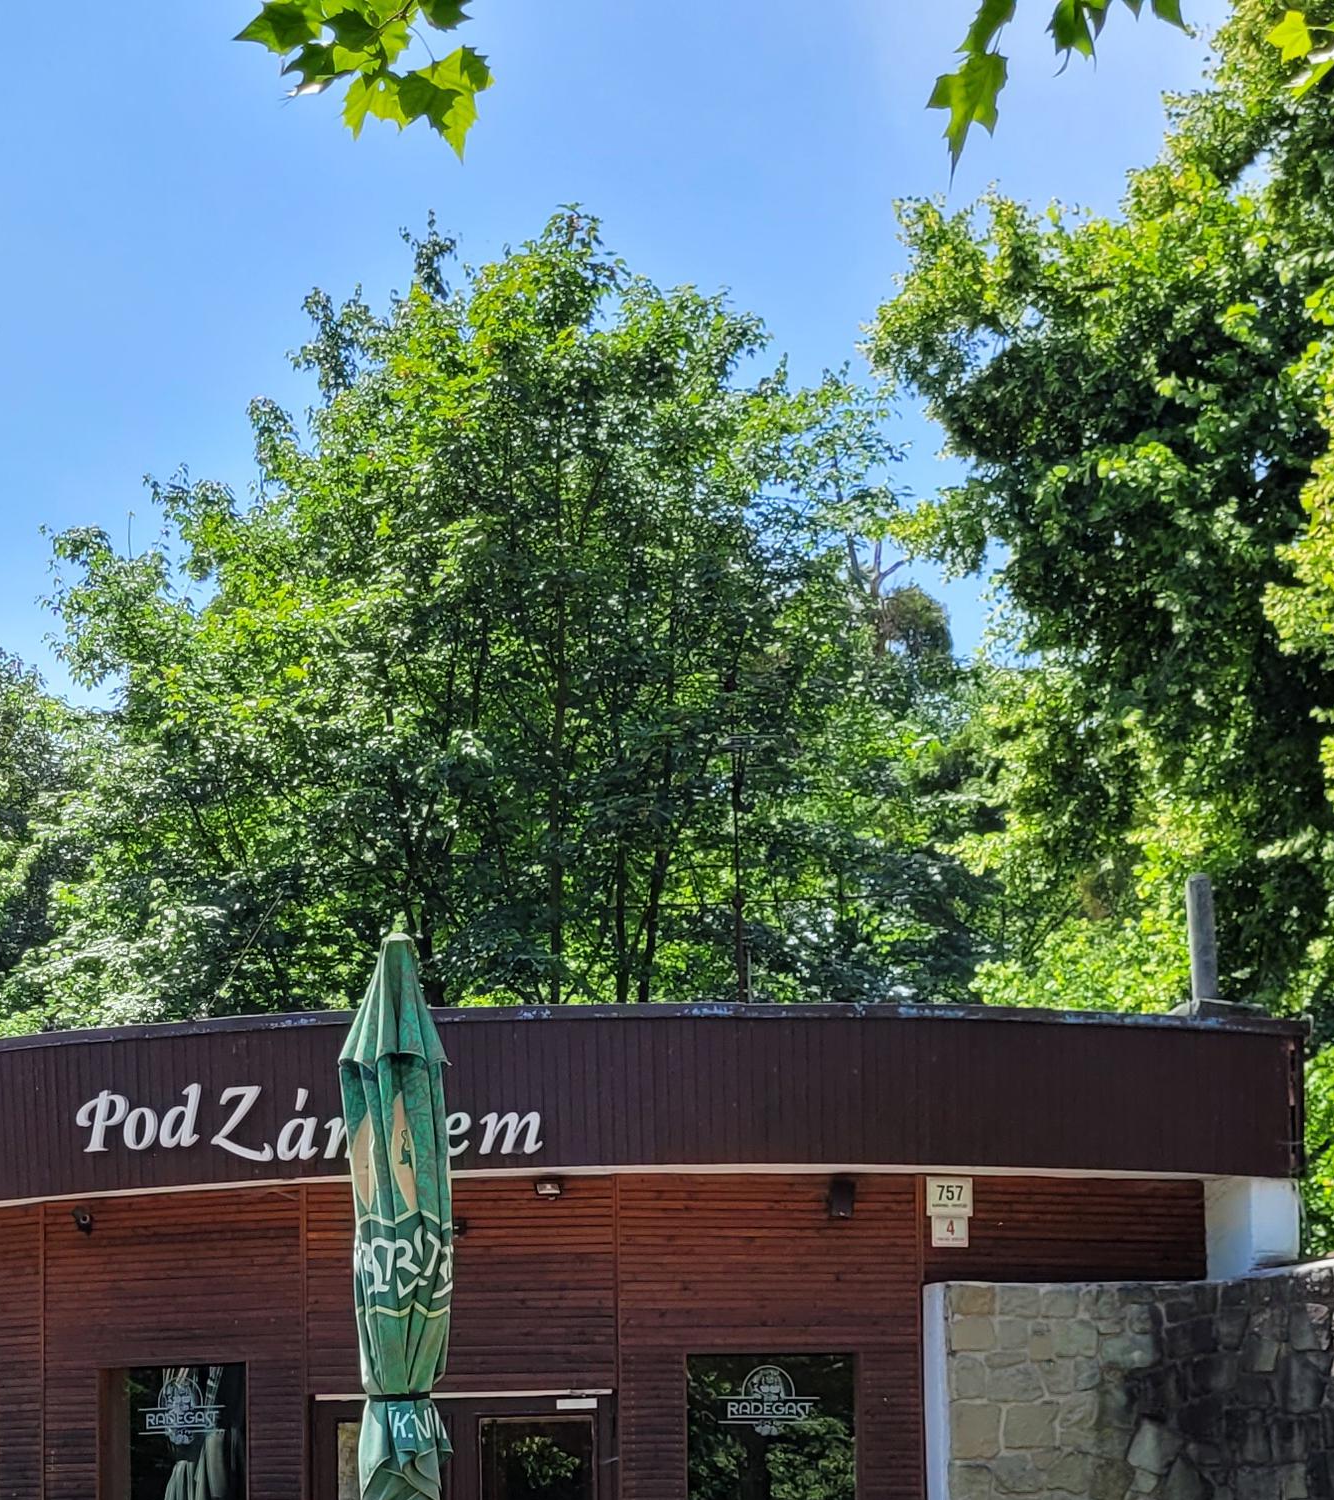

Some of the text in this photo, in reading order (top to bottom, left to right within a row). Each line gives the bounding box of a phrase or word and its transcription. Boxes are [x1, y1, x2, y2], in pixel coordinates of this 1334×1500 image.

[75, 1083, 543, 1162] Pod Záem
[936, 1184, 964, 1201] 757
[946, 1219, 955, 1236] 4
[145, 1410, 220, 1430] RADEGAST
[726, 1401, 814, 1420] RADEGAST
